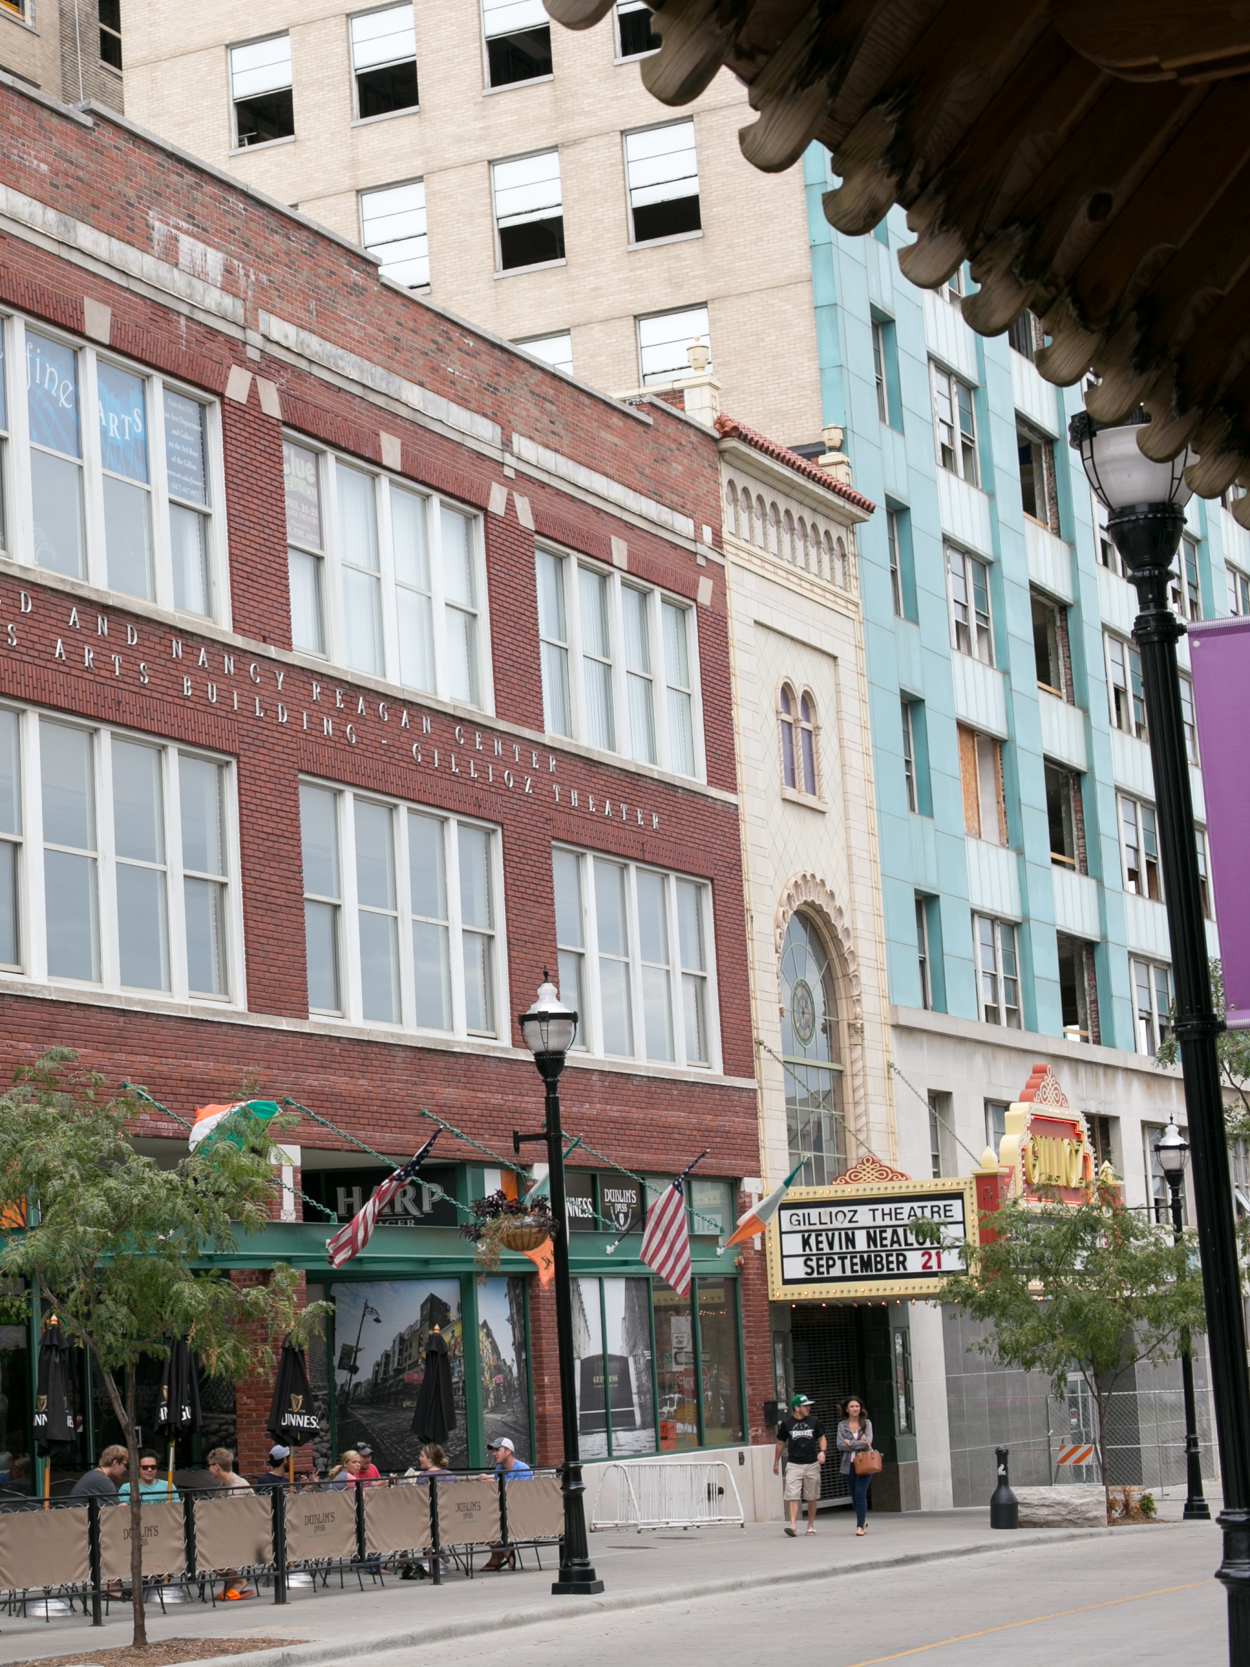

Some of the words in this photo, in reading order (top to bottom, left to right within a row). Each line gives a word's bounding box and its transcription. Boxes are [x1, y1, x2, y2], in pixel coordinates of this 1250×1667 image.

[26, 341, 73, 408] fine
[98, 400, 142, 441] ARTS
[69, 606, 138, 646] AND
[172, 638, 285, 691] NANCY
[312, 681, 432, 735] REAGAN
[455, 726, 557, 774] CENTER
[54, 638, 150, 685] ARTS
[183, 676, 357, 745] BUILDING
[412, 743, 533, 794] GILLIOZ
[553, 784, 661, 831] THEATER
[565, 1197, 593, 1218] NNESS
[604, 1188, 637, 1204] DUBLIN'S
[789, 1209, 859, 1227] GILLIOZ
[868, 1203, 954, 1222] THEATRE
[801, 1230, 857, 1252] KEVIN
[865, 1226, 941, 1249] NEALON
[803, 1252, 908, 1277] SEPTEMBER
[920, 1250, 942, 1271] 21
[592, 1375, 619, 1384] GUIESS
[281, 1412, 320, 1429] UINNES
[123, 1525, 159, 1540] DIN'S
